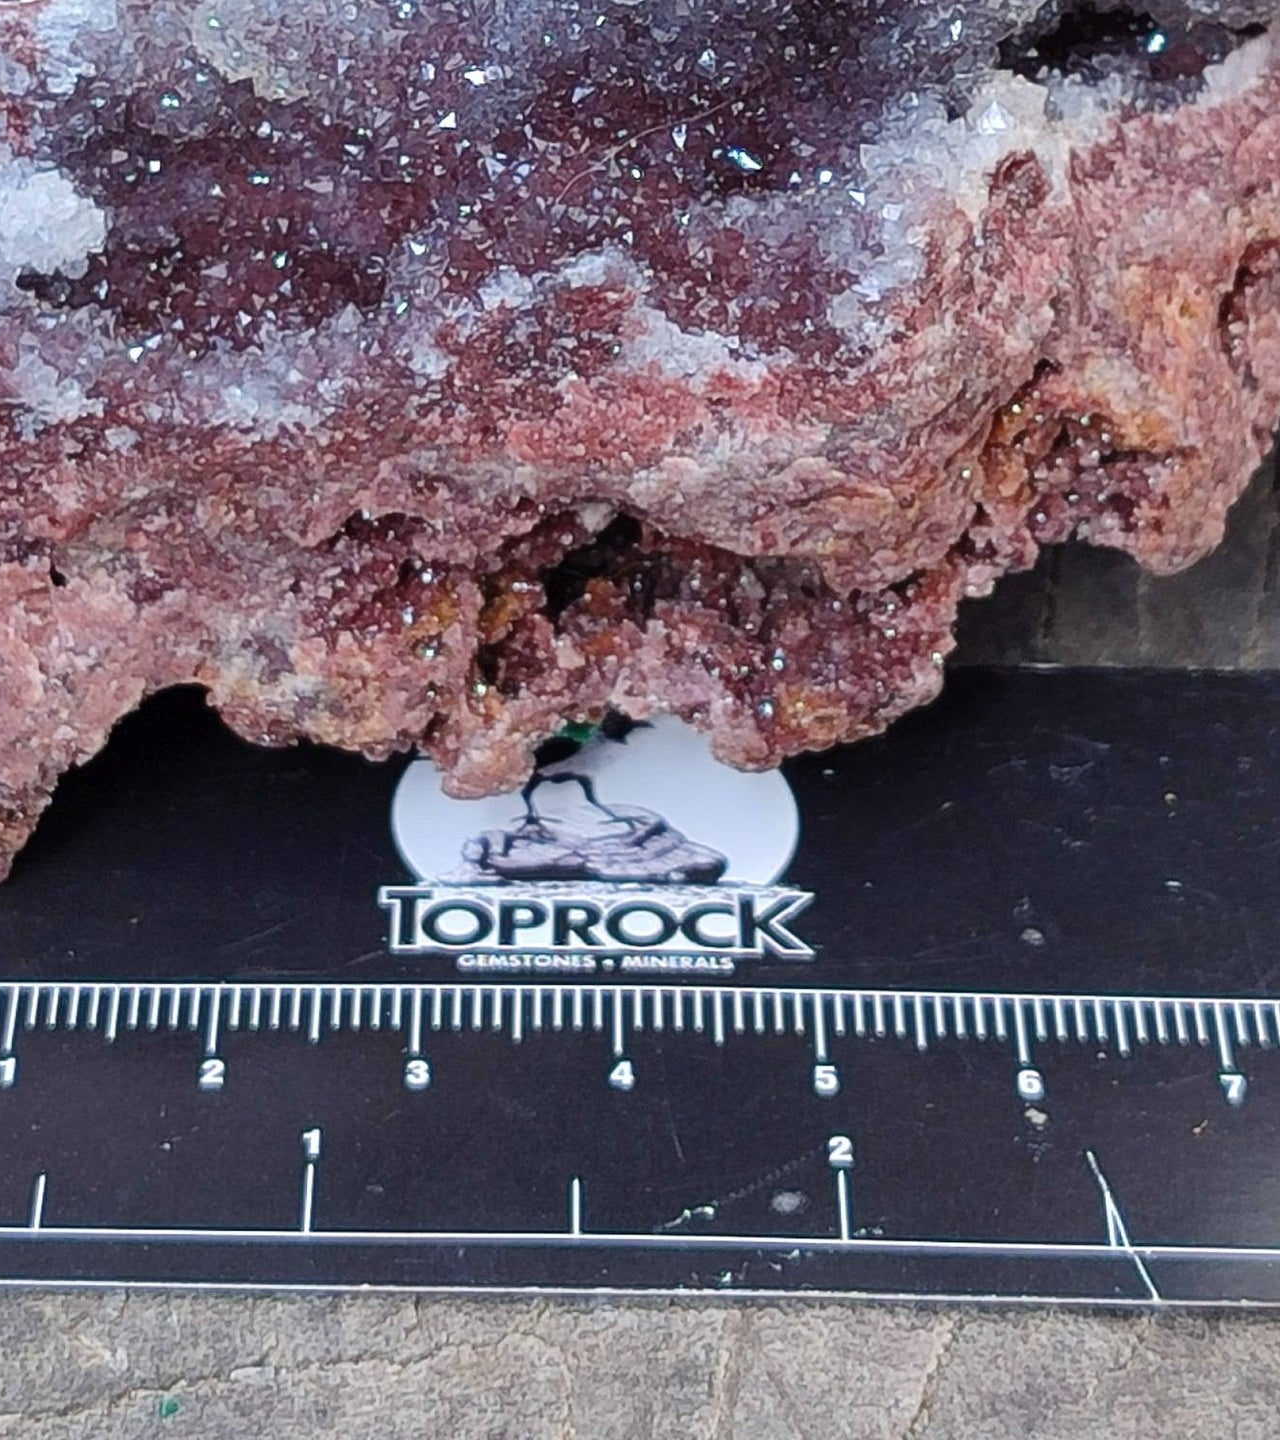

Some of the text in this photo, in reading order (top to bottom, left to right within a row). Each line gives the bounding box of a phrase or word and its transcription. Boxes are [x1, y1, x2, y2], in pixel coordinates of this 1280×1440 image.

[380, 886, 815, 957] TOPROCK
[457, 953, 735, 974] GEMSTONES MINERALS
[199, 1058, 225, 1088] 2
[405, 1059, 430, 1088] 3
[609, 1060, 635, 1089] 4
[814, 1065, 839, 1093] 5
[1018, 1069, 1043, 1097] 6
[1219, 1074, 1246, 1102] 7
[302, 1128, 321, 1158] 1
[828, 1135, 854, 1165] 2
